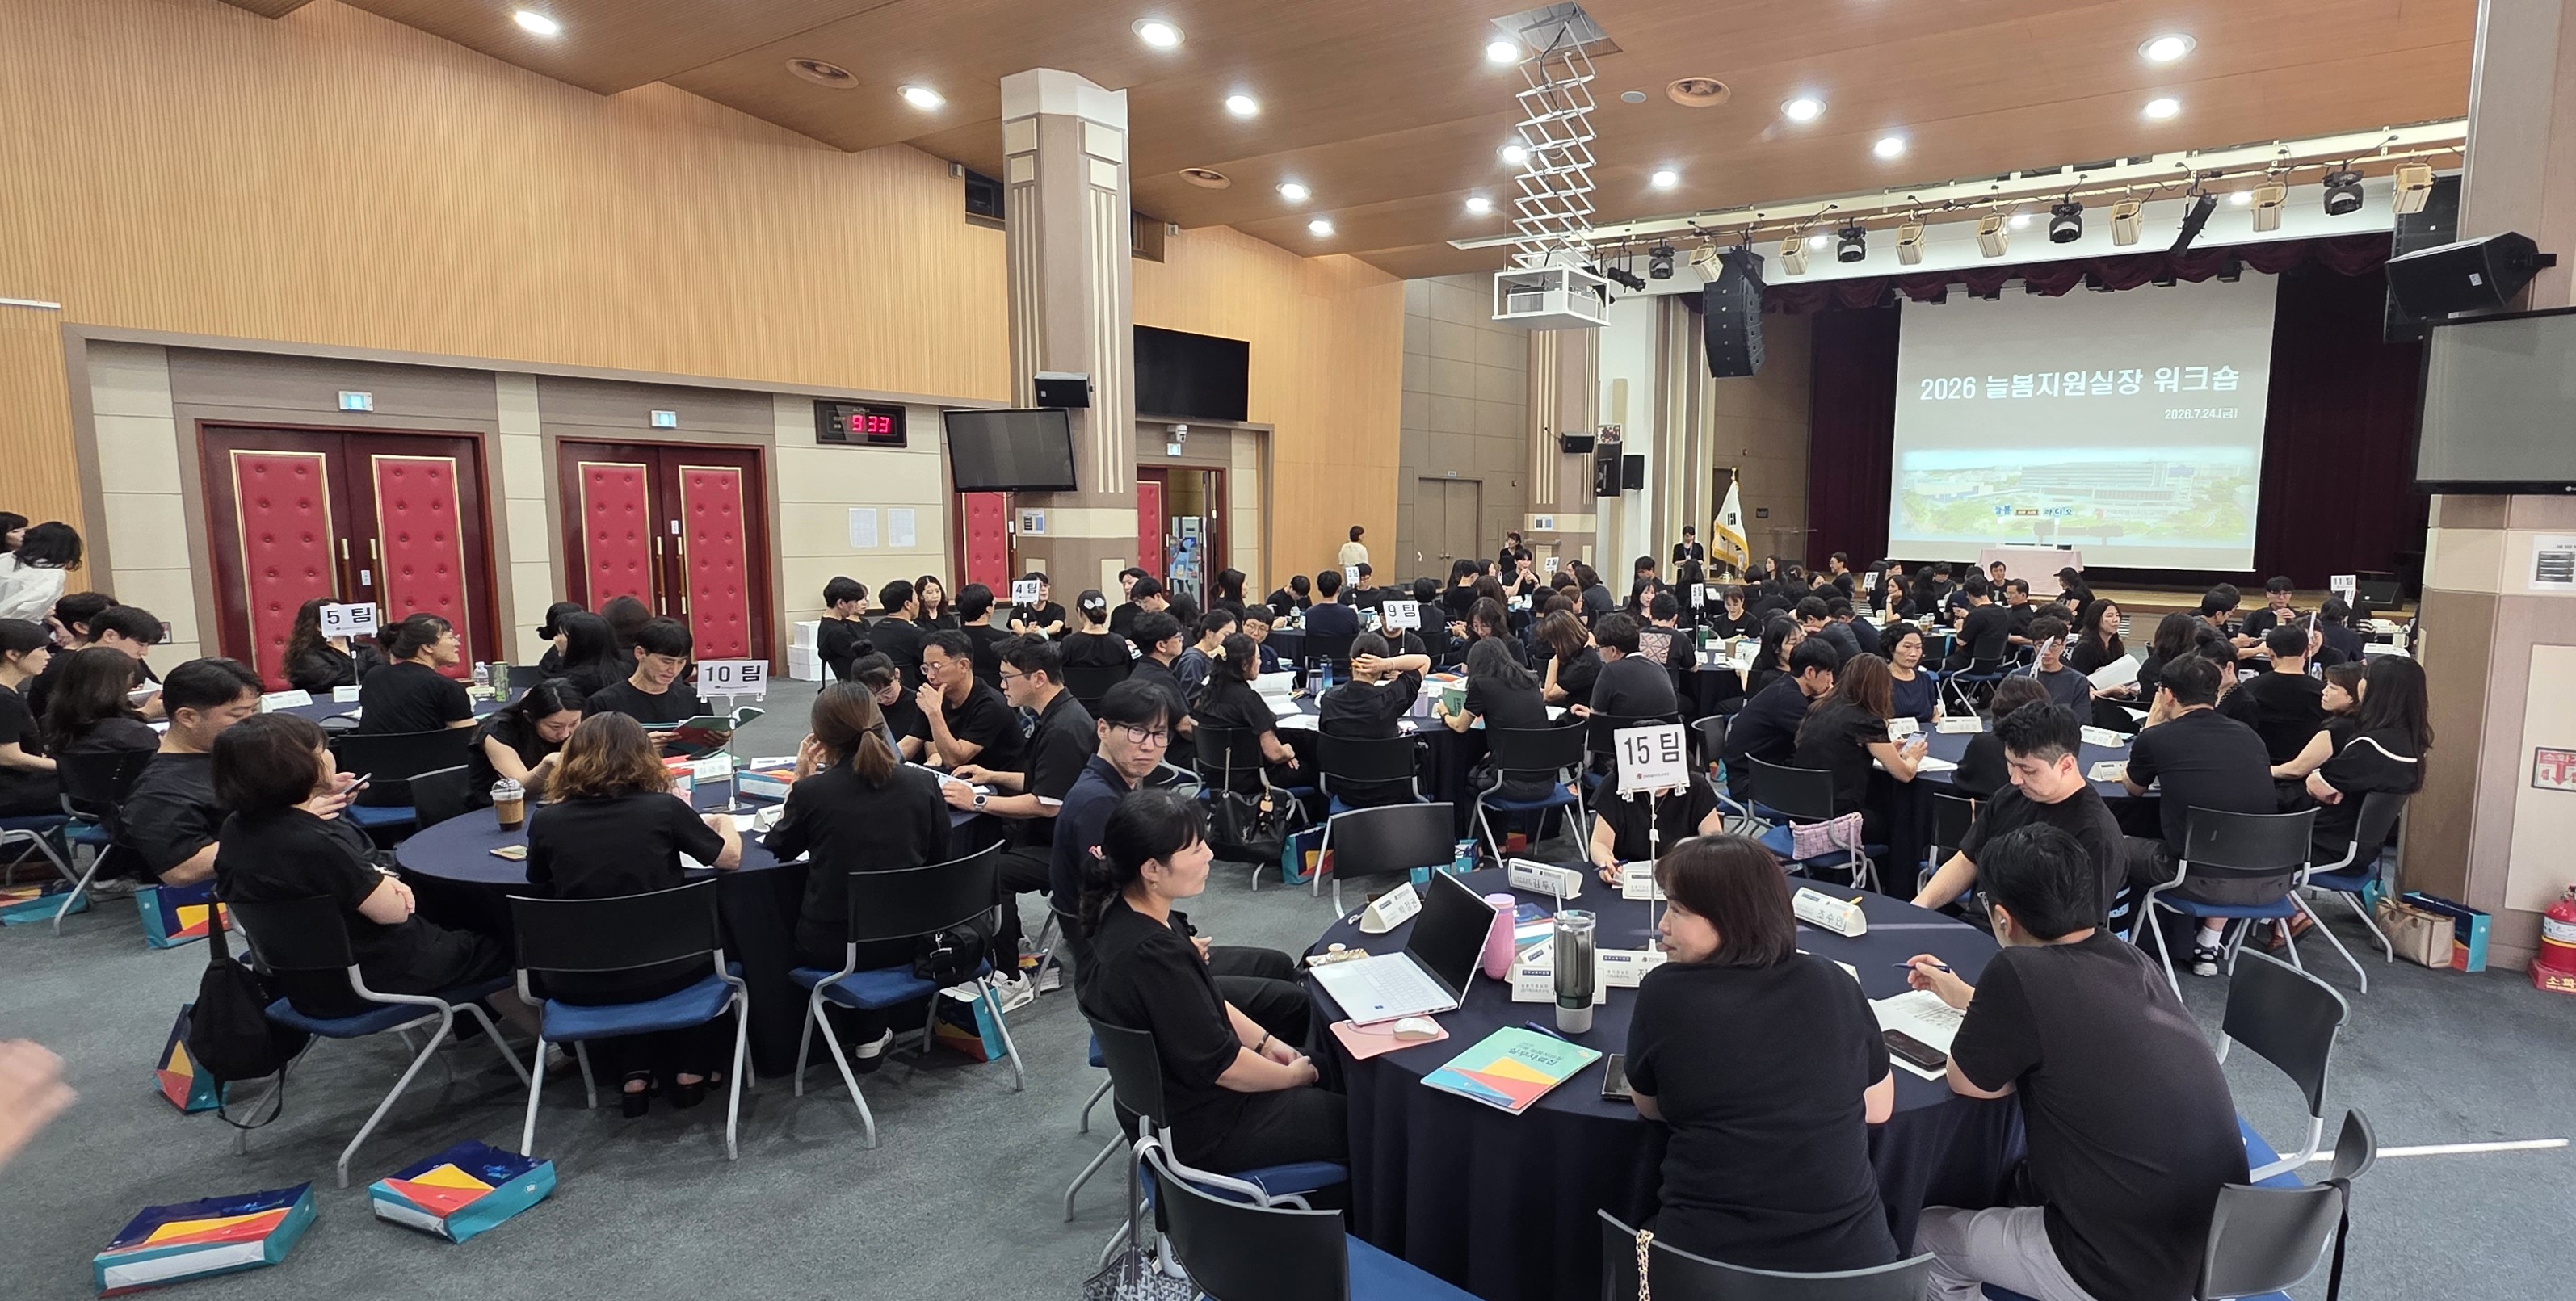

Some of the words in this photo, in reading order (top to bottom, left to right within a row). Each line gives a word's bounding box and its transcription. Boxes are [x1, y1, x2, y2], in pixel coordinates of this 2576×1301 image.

[1919, 376, 1976, 401] 2026
[1985, 368, 2144, 400] 늘봄지원실장
[2154, 365, 2240, 393] 워크숍
[1015, 583, 1023, 594] 4
[1027, 582, 1037, 594] 팀
[2334, 577, 2342, 585] 11
[326, 610, 340, 624] 5
[351, 606, 372, 623] 팀
[1388, 604, 1397, 617] 9
[1402, 604, 1416, 618] 팀
[704, 665, 731, 682] 10
[742, 665, 761, 682] 팀
[1624, 736, 1649, 766] 15
[1659, 732, 1679, 763] 팀
